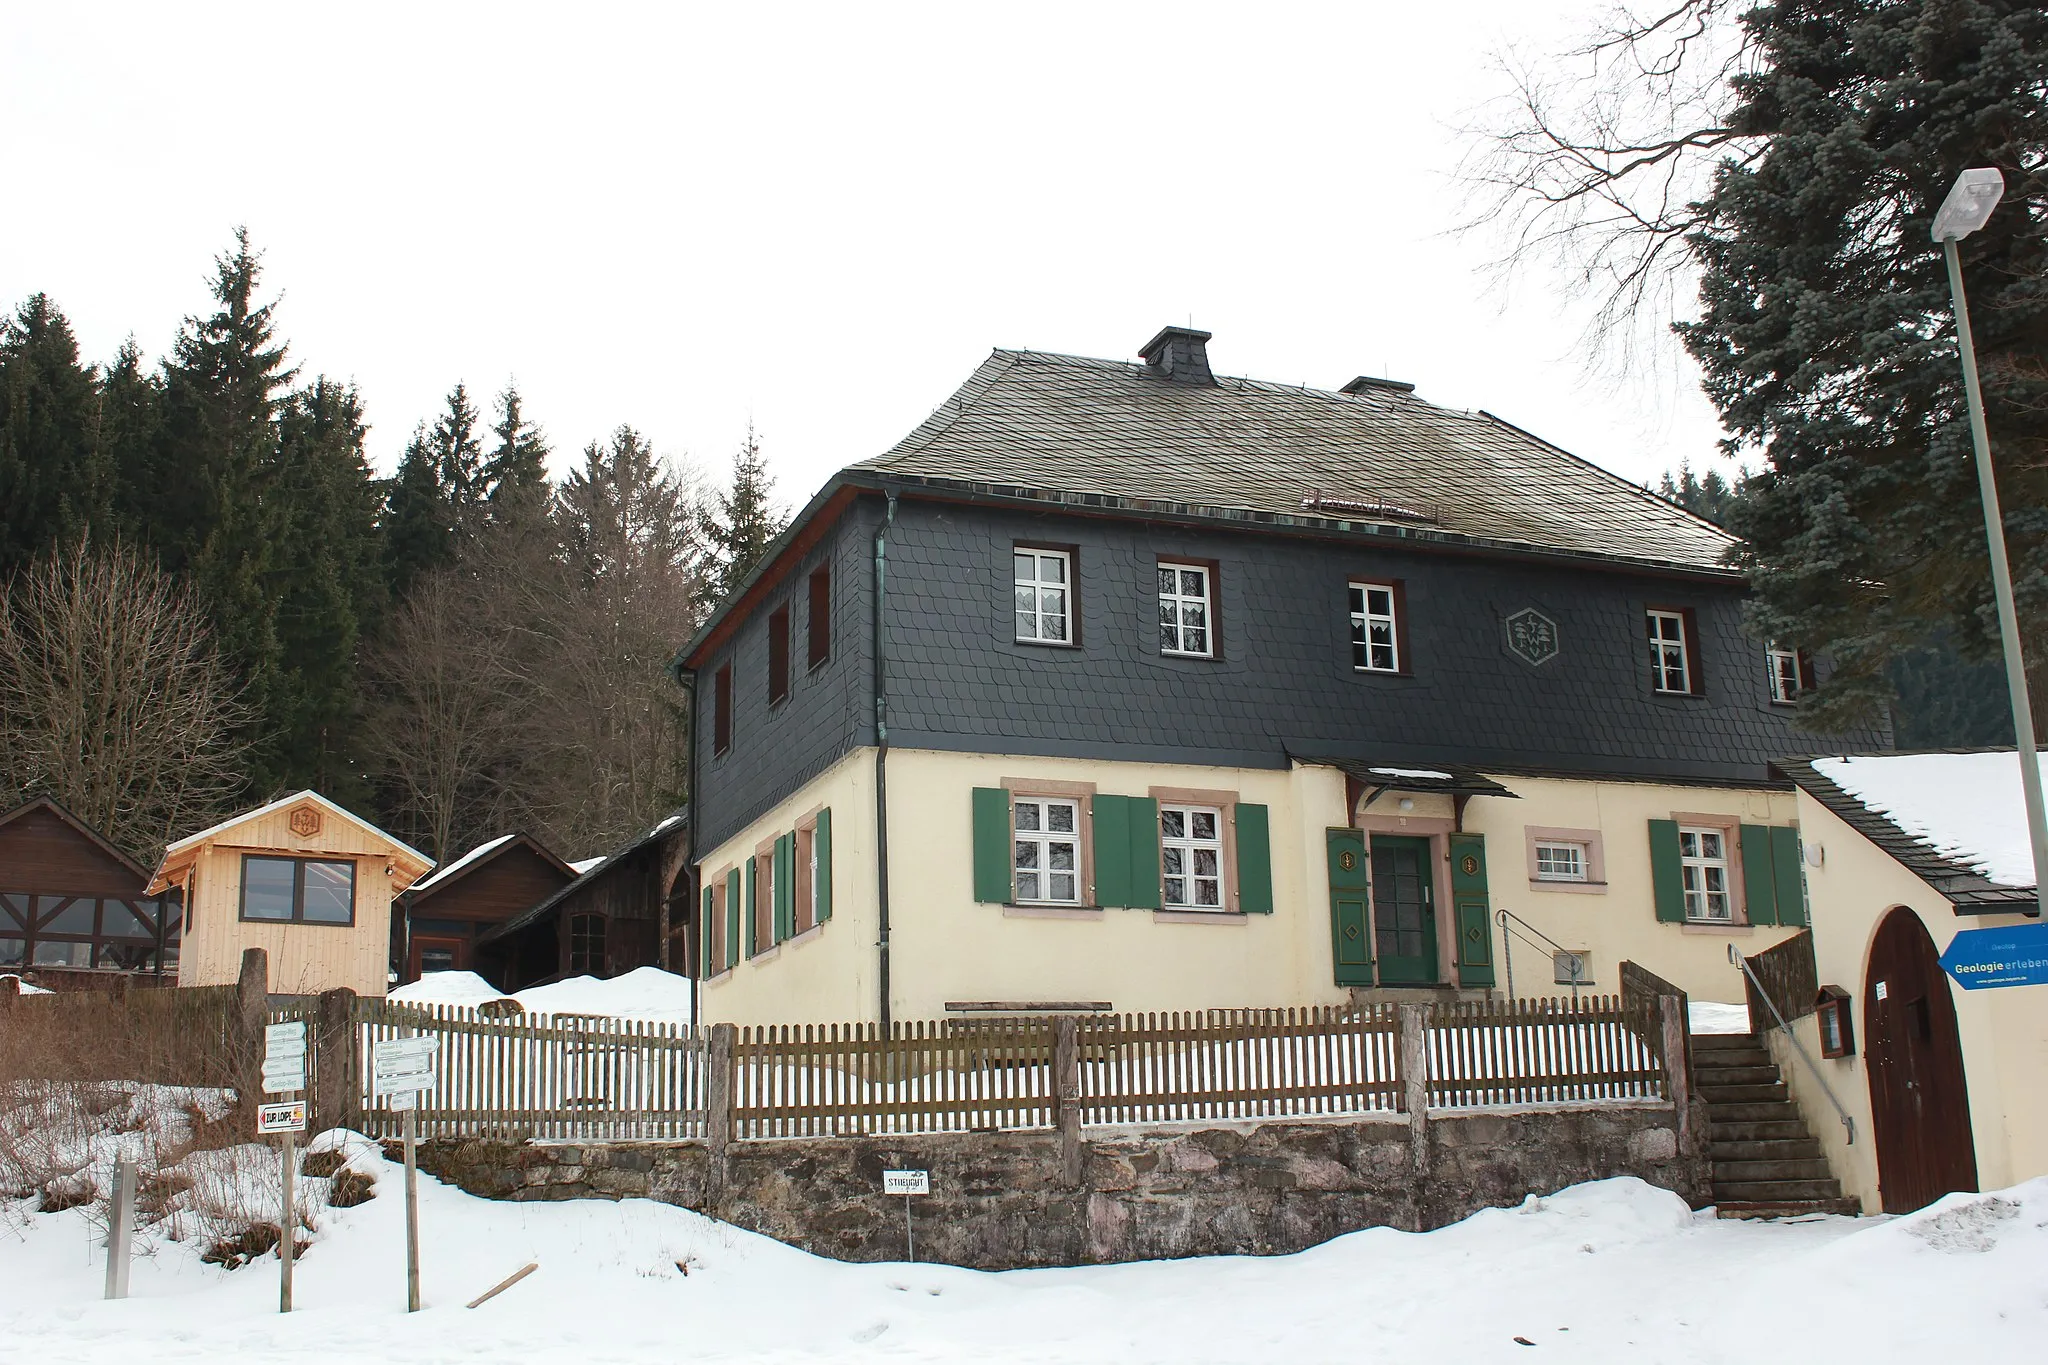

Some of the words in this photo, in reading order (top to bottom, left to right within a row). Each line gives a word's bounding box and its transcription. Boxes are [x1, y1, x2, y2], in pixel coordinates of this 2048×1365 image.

[1955, 961, 2004, 974] Geologie
[2005, 959, 2048, 970] erleben
[266, 1112, 277, 1123] ZUR
